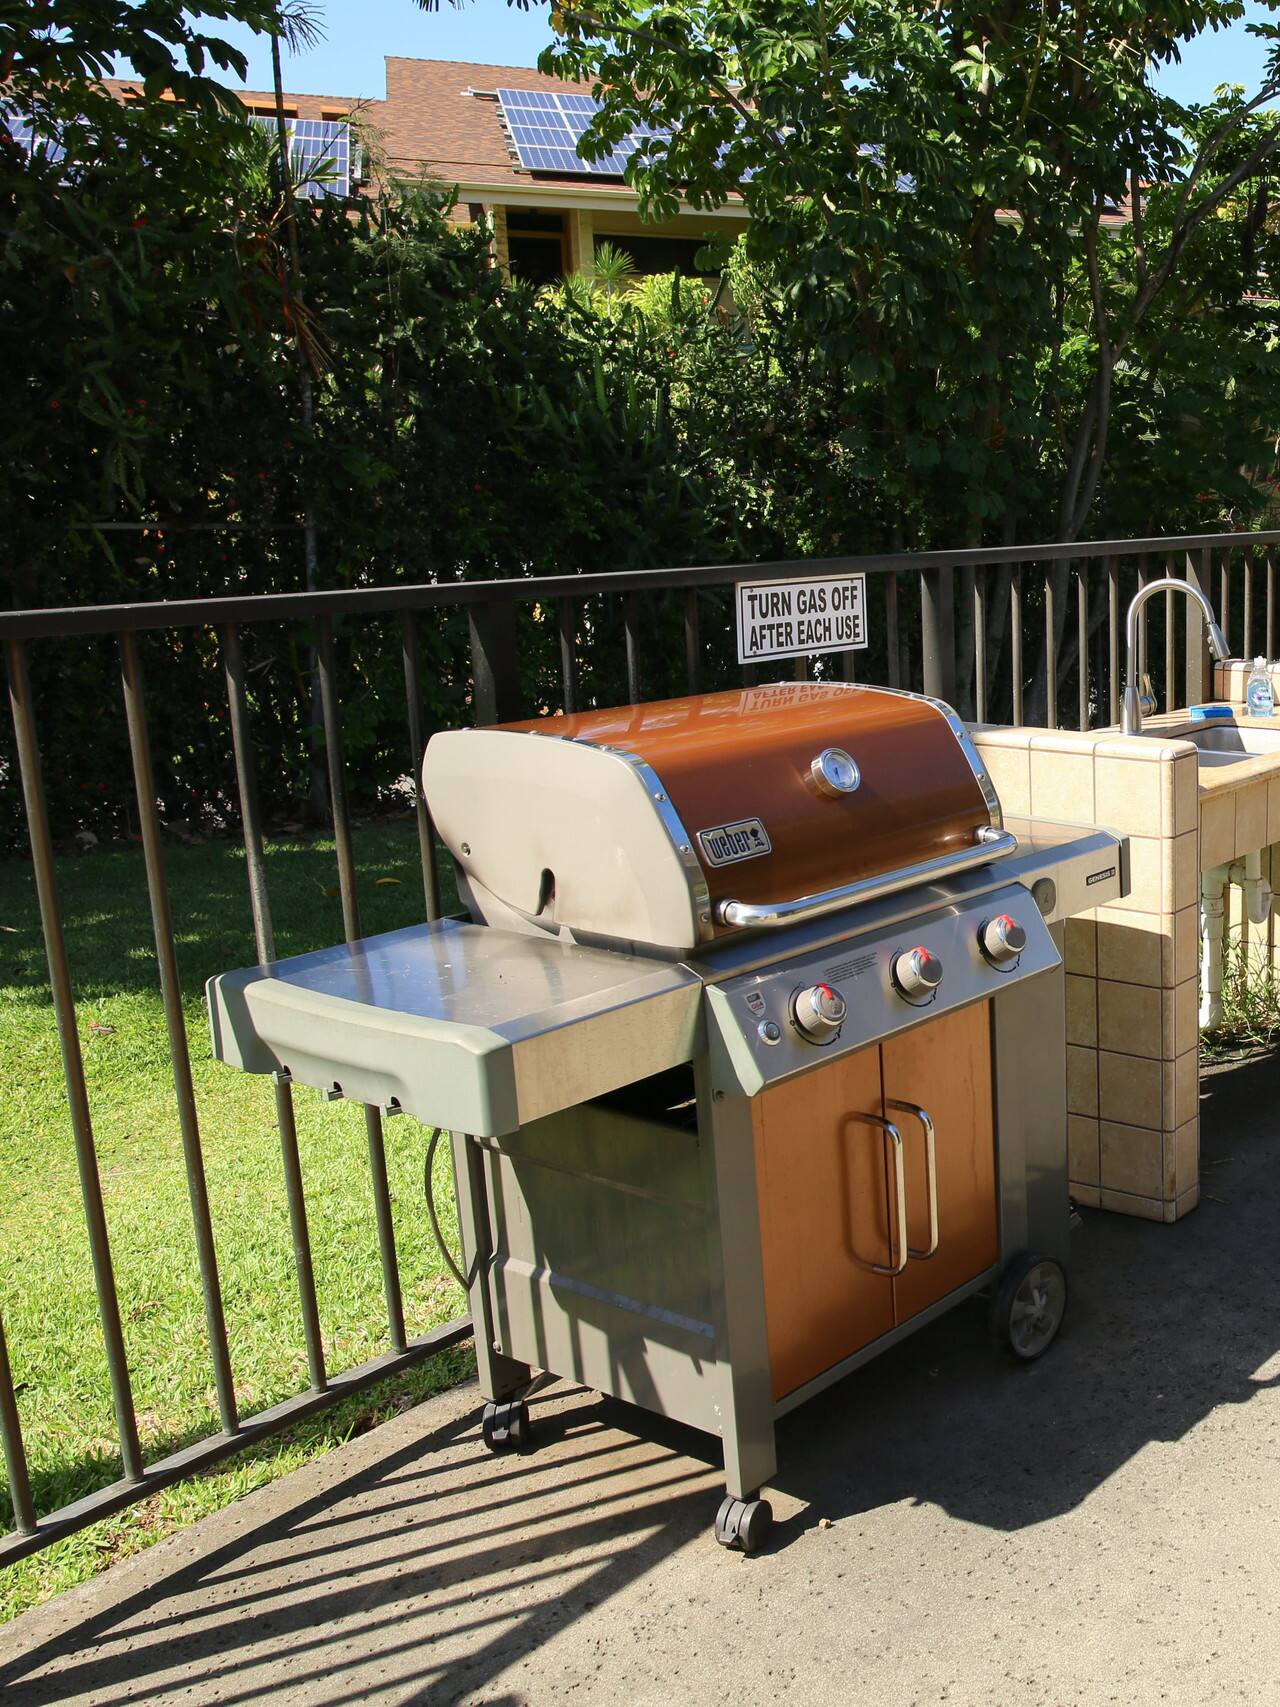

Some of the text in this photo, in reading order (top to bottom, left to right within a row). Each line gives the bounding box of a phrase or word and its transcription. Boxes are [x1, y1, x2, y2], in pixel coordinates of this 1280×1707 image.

[748, 585, 858, 620] TURN GAS OFF
[749, 614, 860, 651] AFTER EACH USE
[708, 831, 751, 859] weber
